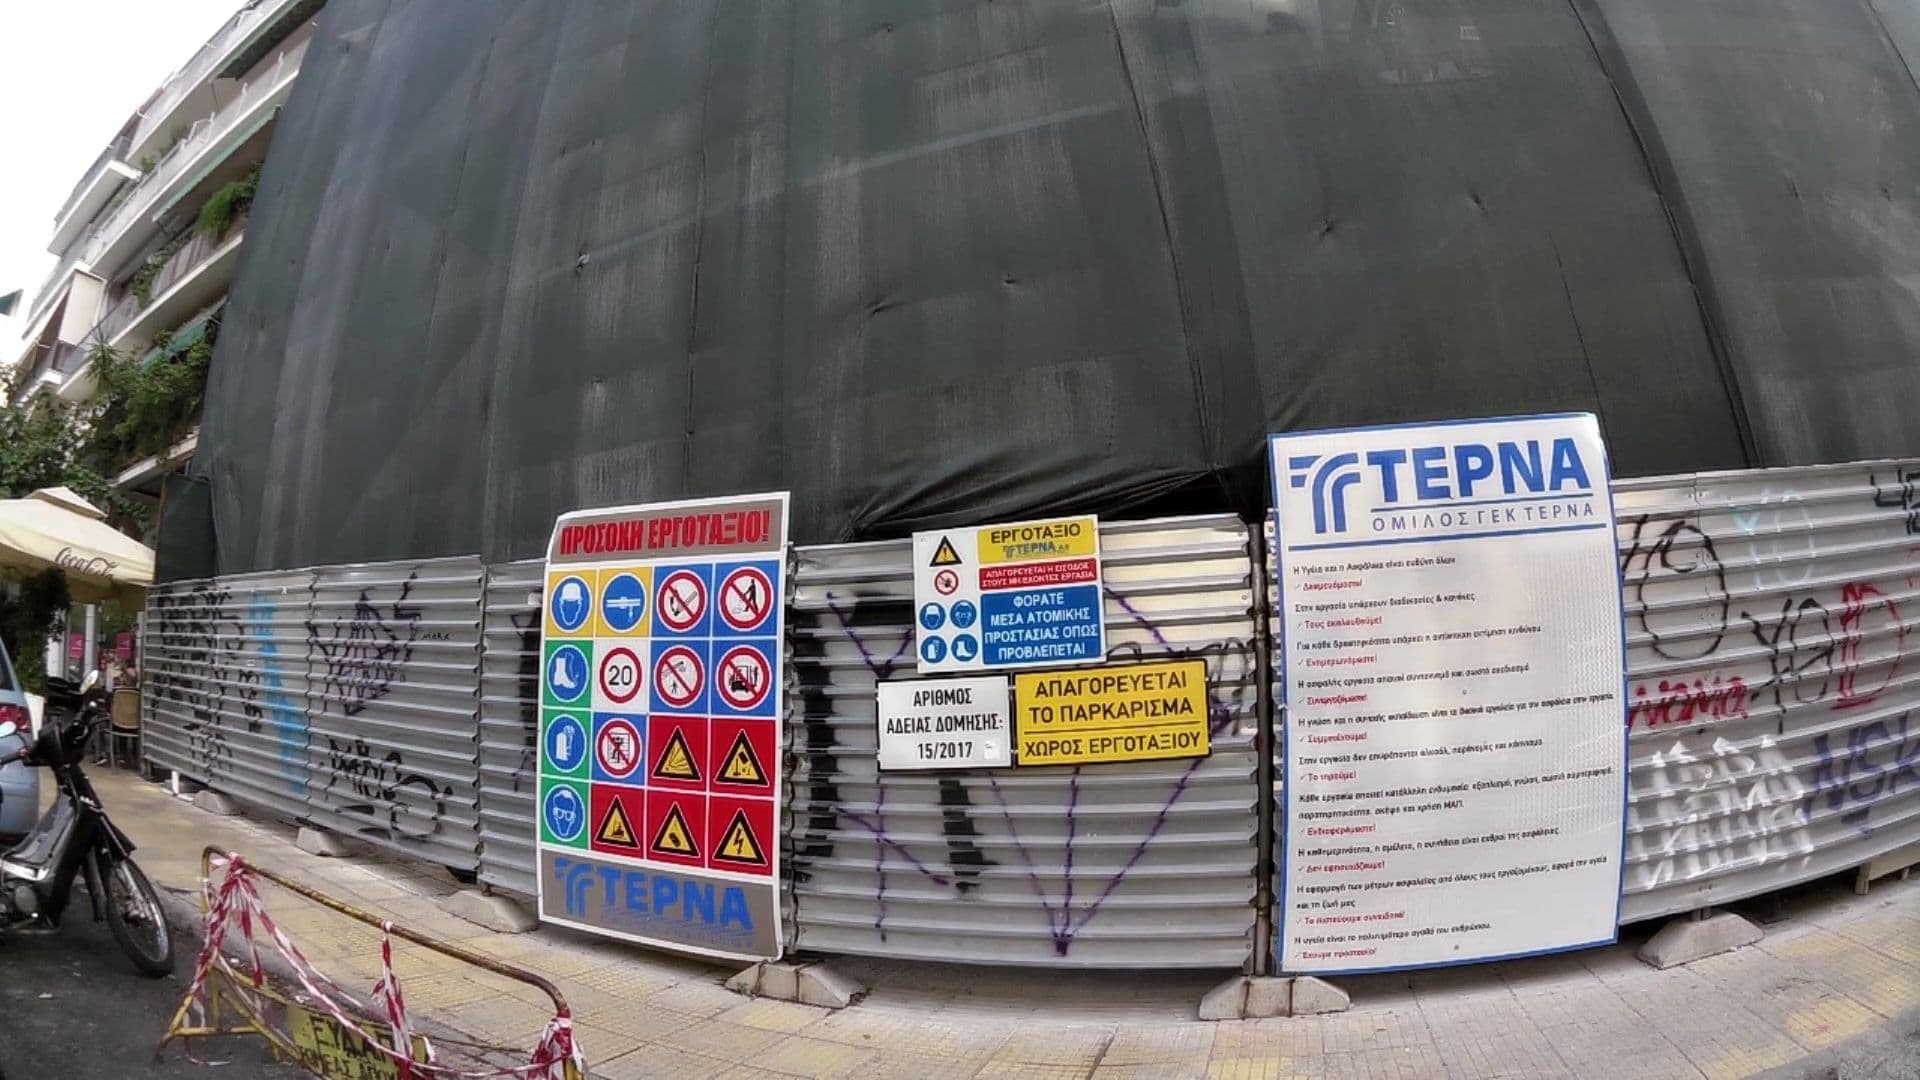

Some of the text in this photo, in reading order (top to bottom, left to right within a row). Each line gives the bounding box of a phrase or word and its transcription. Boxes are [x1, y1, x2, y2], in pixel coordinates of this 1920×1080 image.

[1367, 438, 1592, 503] ΤΕΡΝΑ
[1372, 502, 1594, 531] ΟΜΙΛΟΣ ΓΕΚ ΤΕΡΝΑ
[560, 509, 770, 555] ΠΡΟΣΟΧΗ ΕΡΓΟΤΑΞΙΟ!
[991, 523, 1081, 544] ΕΡΓΟΤΑΞΙΟ
[982, 578, 1007, 588] ΣΤΟΥΣ
[1061, 572, 1095, 581] ΕΡΓΑΣΙΑ
[986, 565, 1046, 578] ΑΠΑΓΟΡΕΥΕΤΑΙ
[1055, 562, 1089, 572] ΕΙΣΟΔΟΣ
[1013, 592, 1065, 608] ΦΟΡΑΤΕ
[990, 607, 1091, 627] ΜΕΣΑ ΑΤΟΜΙΚΗΣ
[984, 624, 1099, 644] ΠΡΟΣΤΑΣΙΑΣ ΟΠΩΣ
[998, 643, 1086, 660] ΠΡΟΒΛΕΠΕΤΑΙ
[608, 664, 633, 687] 20
[1035, 671, 1187, 698] ΑΠΑΓΟΡΕΥΕΤΑΙ
[913, 688, 972, 707] ΑΡΙΘΜΟΣ
[1029, 697, 1194, 724] ΤΟ ΠΑΡΚΑΡΙΣΜΑ
[886, 713, 1003, 734] ΑΔΕΙΑΣ ΔΟΜΗΣΗΣ:
[918, 741, 973, 759] 15/2017
[1024, 732, 1201, 757] ΧΩΡΟΣ ΕΡΓΟΤΑΞΙΟΥ
[597, 867, 754, 931] ΤΕΡΝΑ
